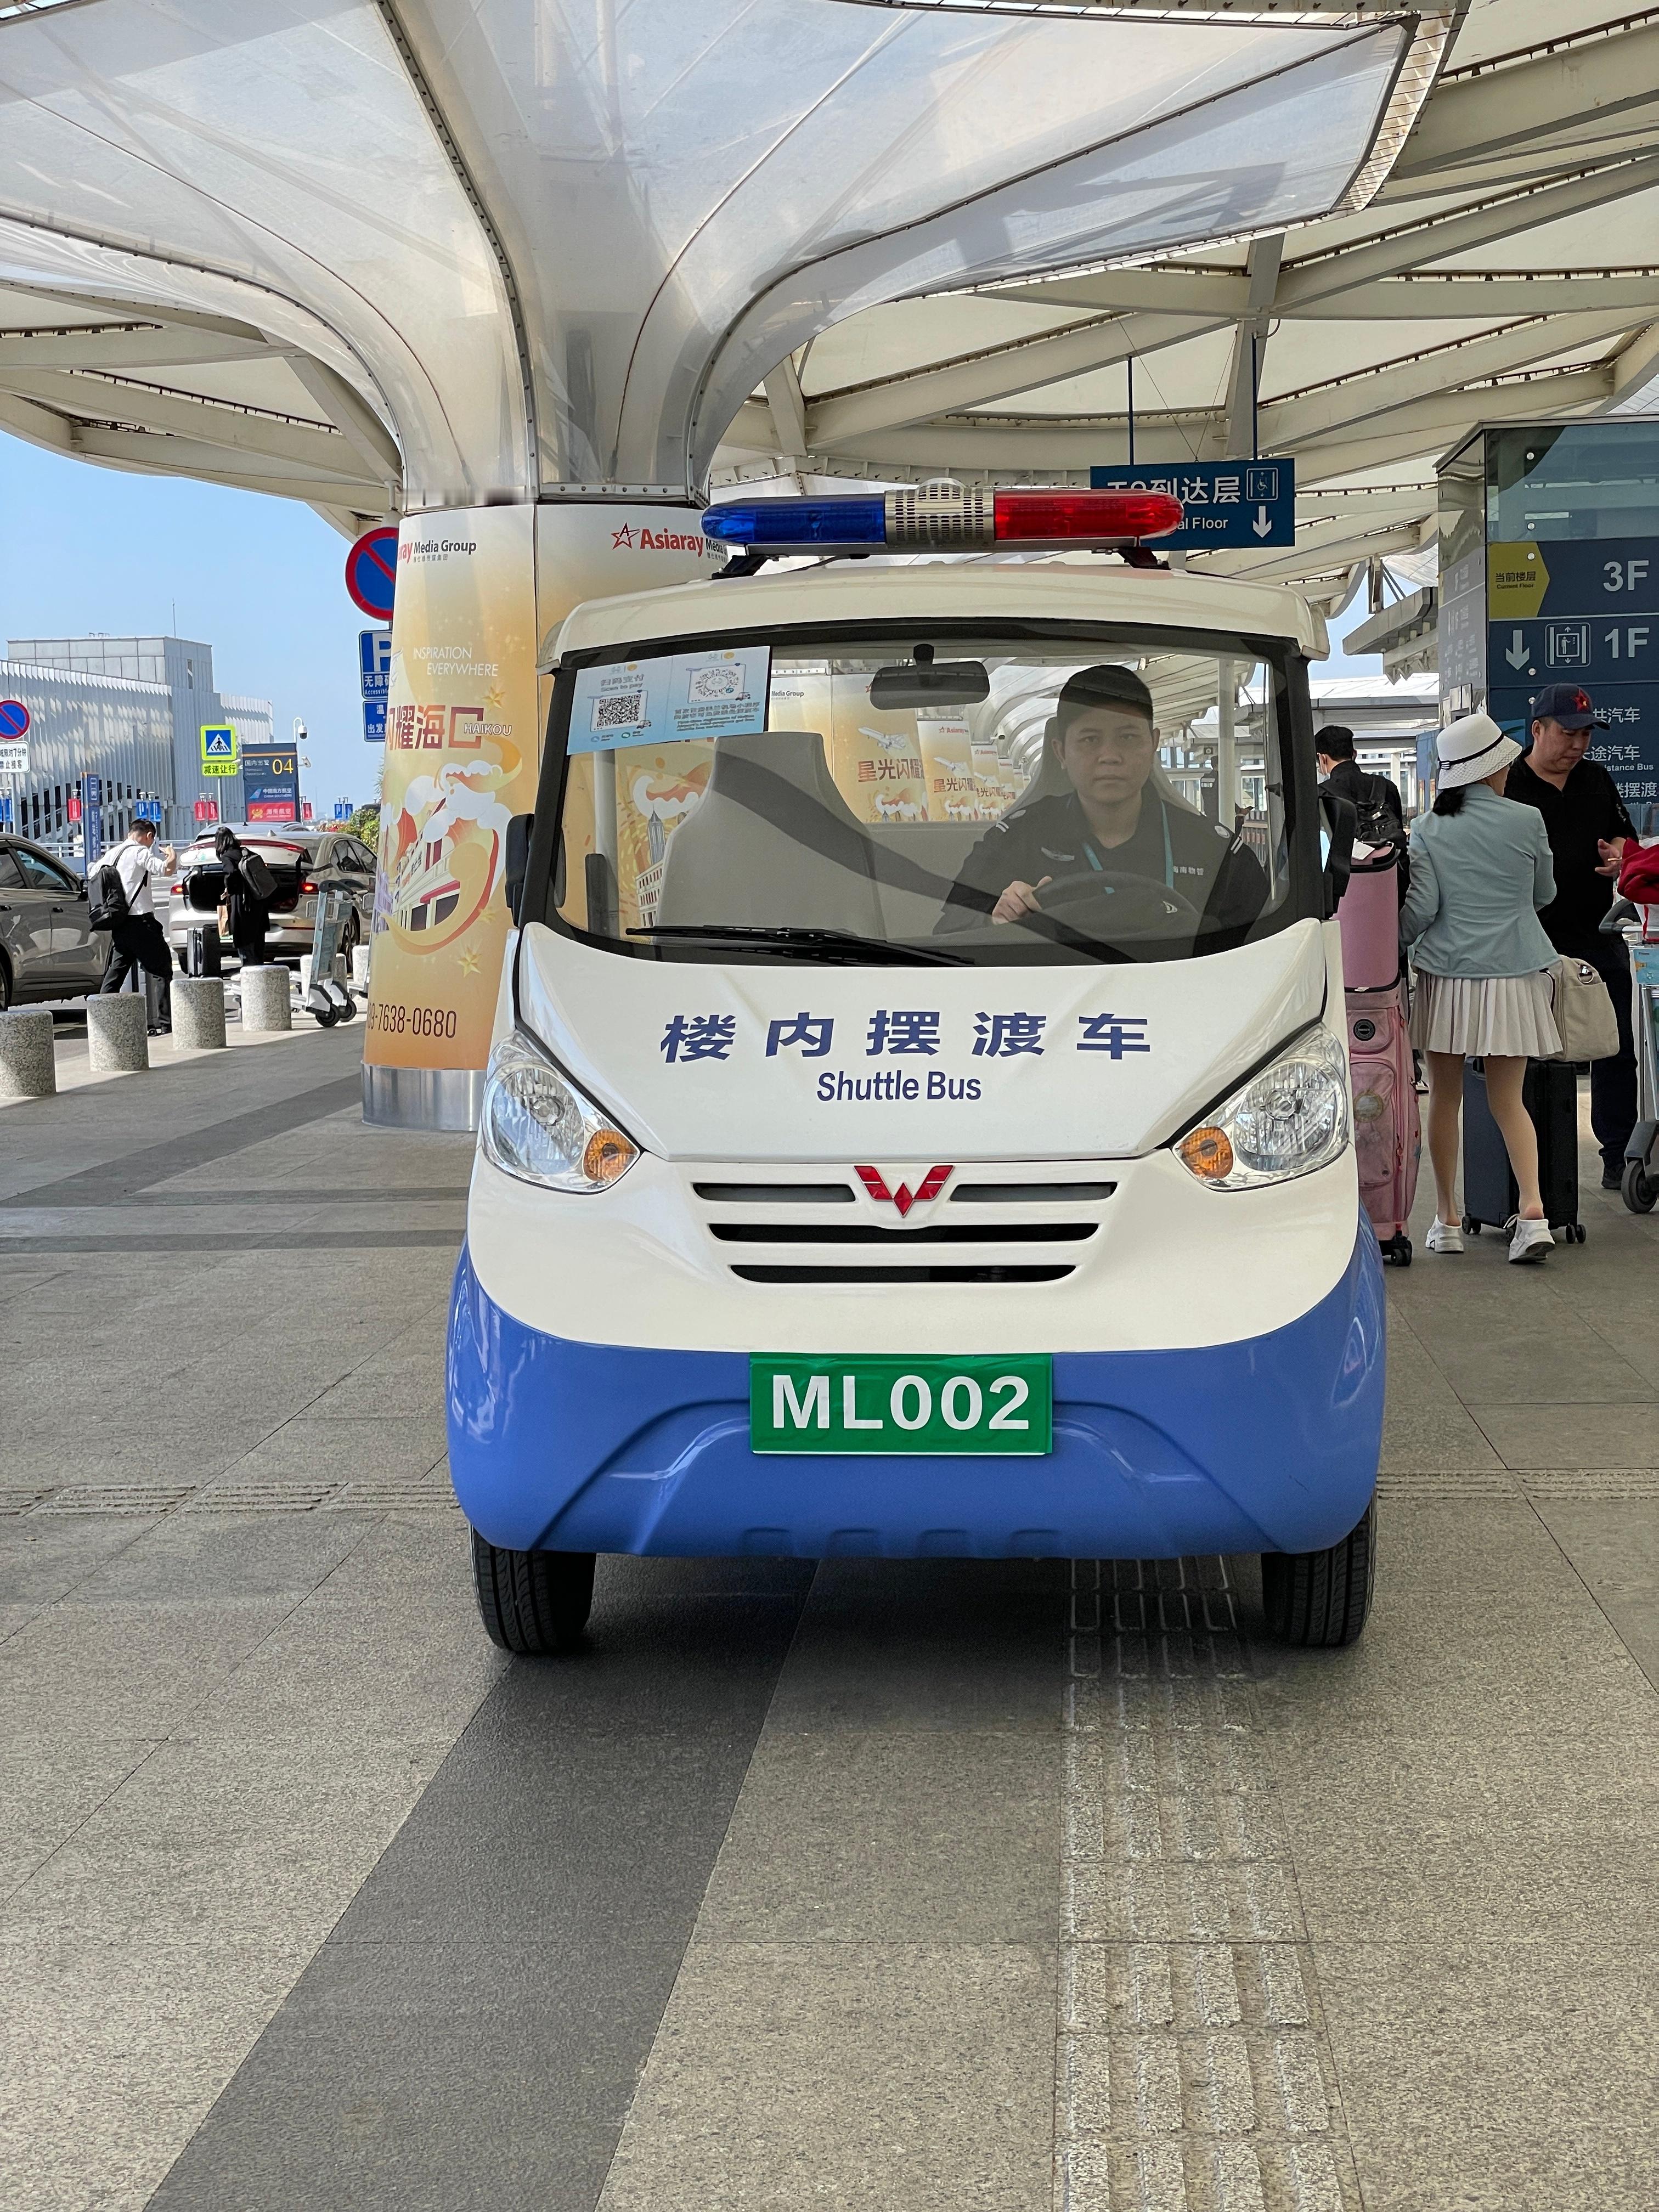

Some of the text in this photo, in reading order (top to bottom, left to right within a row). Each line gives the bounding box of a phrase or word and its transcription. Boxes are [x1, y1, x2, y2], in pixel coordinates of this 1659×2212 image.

[1193, 517, 1228, 529] Floor
[414, 540, 439, 554] Media
[441, 539, 477, 555] Group
[640, 528, 703, 557] Asiaray
[1496, 571, 1536, 582] 当前楼层
[1603, 560, 1649, 591] 3F
[1605, 627, 1650, 658] 1F
[372, 633, 392, 672] P
[413, 646, 472, 659] INSPIRATION
[427, 662, 499, 676] EVERYWHERE
[464, 723, 512, 736] HAIKOU
[204, 764, 236, 774] 减速让行
[272, 759, 294, 775] 04
[661, 1010, 1151, 1063] 楼内摆渡车
[817, 1069, 981, 1101] Shuttle Bus
[773, 1374, 1029, 1430] ML002
